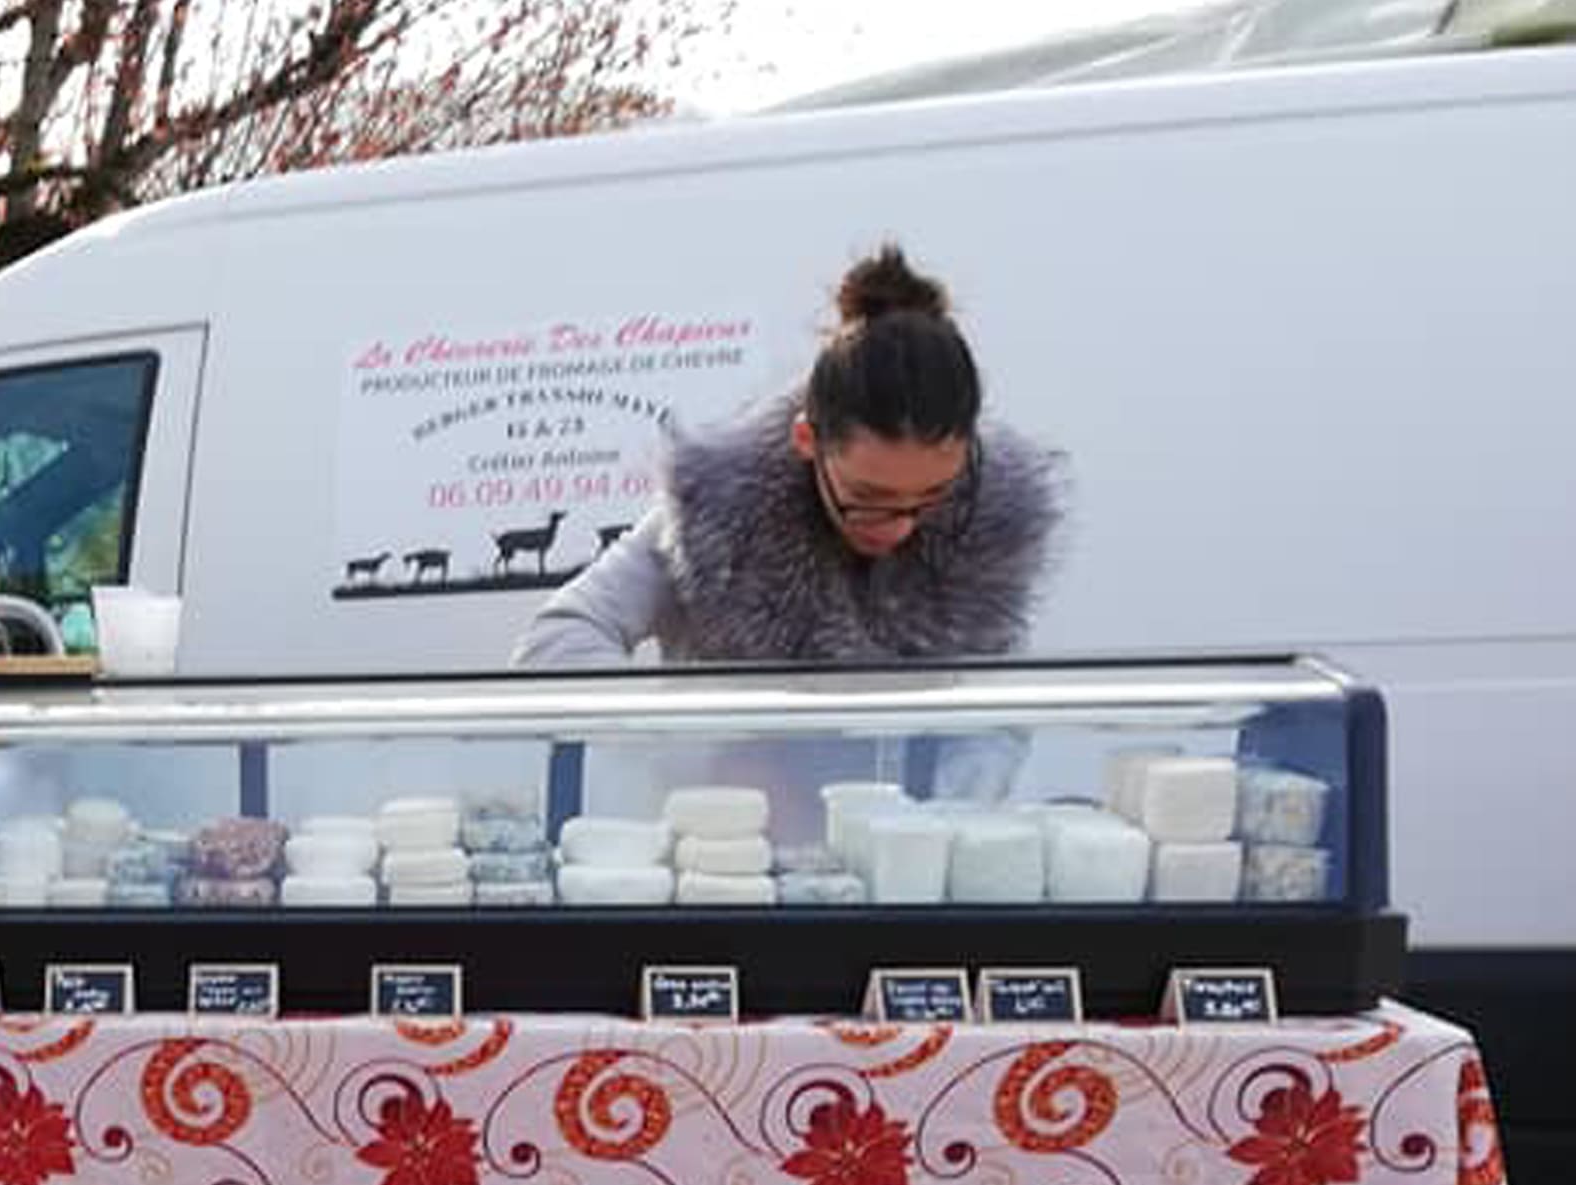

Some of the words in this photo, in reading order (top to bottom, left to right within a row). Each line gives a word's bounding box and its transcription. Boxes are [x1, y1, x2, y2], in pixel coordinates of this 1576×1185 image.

[359, 366, 493, 395] PRODUCTEUR
[495, 364, 519, 383] DE
[526, 355, 625, 382] FROMAGE
[630, 353, 657, 371] DE
